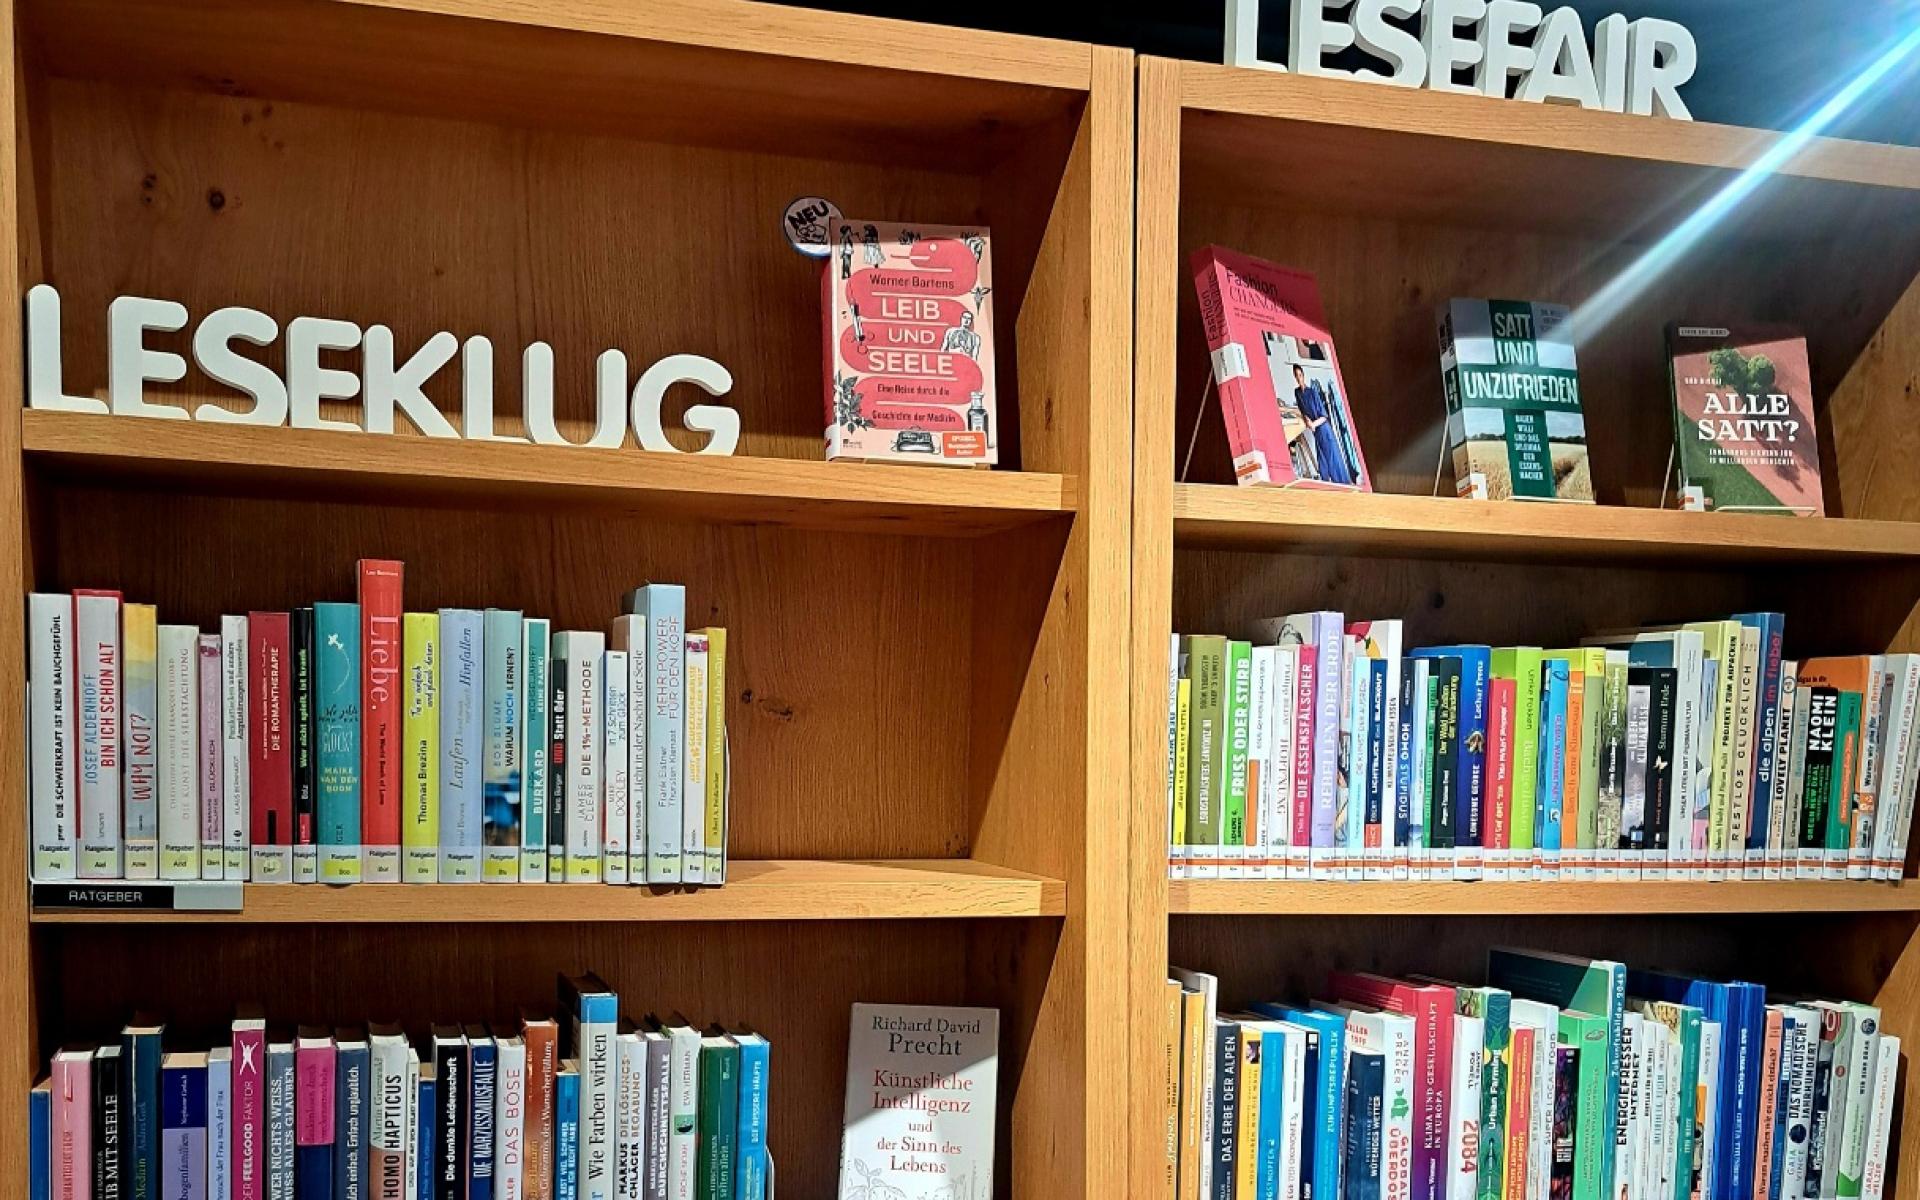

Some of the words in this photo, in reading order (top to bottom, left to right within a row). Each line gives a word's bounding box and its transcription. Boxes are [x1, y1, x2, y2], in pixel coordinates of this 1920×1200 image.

[1223, 0, 1697, 120] LESEFAIR
[788, 201, 829, 229] NEU
[870, 273, 908, 287] Werner
[912, 274, 954, 290] Bartens
[881, 297, 940, 320] LEIB
[1494, 313, 1531, 338] SATT
[888, 328, 935, 344] UND
[1497, 341, 1536, 365] UND
[27, 284, 740, 456] LESEKLUG
[869, 350, 954, 375] SEELE
[1465, 371, 1578, 404] UNZUFRIEDEN
[1704, 393, 1790, 415] ALLE
[1698, 419, 1799, 442] SATT?
[50, 615, 61, 685] BAUCHGEFÜHL
[658, 618, 667, 672] POWER
[670, 616, 679, 653] KOPF
[99, 643, 114, 664] ALT
[299, 649, 307, 676] krank
[370, 613, 399, 710] Liebe.
[459, 629, 473, 686] Hinfallen
[505, 647, 514, 691] LERNEN?
[634, 650, 643, 678] Seele
[1325, 629, 1339, 677] ERDE
[1767, 632, 1780, 679] fieber
[271, 647, 280, 731] ROMANTHERAPIE
[299, 679, 307, 691] ist
[634, 680, 643, 697] der
[669, 657, 679, 688] DEN
[1235, 658, 1249, 703] STIRB
[54, 688, 62, 711] KEIN
[84, 673, 97, 744] ALDENHOFF
[99, 669, 114, 713] SCHON
[505, 693, 514, 724] NOCH
[554, 688, 565, 712] Oder
[581, 661, 591, 750] 1%-METHODE
[657, 677, 667, 716] MEHR
[669, 691, 679, 719] FÜR
[1323, 680, 1338, 716] DER
[1374, 672, 1382, 721] BLACKOUT
[1660, 684, 1670, 706] Erde
[1722, 706, 1731, 746] PROJEKTE
[1728, 636, 1737, 680] ANPACKEN
[1765, 685, 1775, 702] im
[54, 714, 63, 728] IST
[100, 718, 114, 739] ICH
[554, 715, 565, 740] Statt
[634, 700, 643, 730] Nacht
[1233, 706, 1248, 749] ODER
[1298, 664, 1312, 775] ESSENSFÄLSCHER
[1657, 710, 1668, 750] Stumme
[1735, 665, 1752, 759] GLÜCKLICH
[1762, 708, 1775, 752] alpen
[1808, 695, 1824, 750] NAOMI
[1822, 696, 1837, 751] KLEIN
[130, 714, 151, 756] NOT?
[272, 734, 280, 750] DIE
[299, 723, 307, 746] nicht
[505, 726, 514, 767] WARUM
[634, 735, 643, 750] der
[1400, 723, 1410, 760] HOMO
[1779, 708, 1791, 754] PLANET
[55, 731, 63, 800] SCHWERKRAFT
[84, 749, 98, 785] JOSEF
[101, 744, 115, 767] BIN
[299, 749, 307, 767] Wer
[418, 740, 427, 779] Brezina
[449, 738, 464, 789] Laufen
[554, 742, 563, 763] UND
[581, 754, 591, 776] DIE
[634, 754, 644, 765] in
[1320, 720, 1338, 808] REBELLEN
[1759, 756, 1771, 782] die
[131, 763, 152, 800] WHY
[534, 749, 544, 814] BURKARD
[616, 769, 626, 817] DOOLEY
[634, 769, 644, 792] Licht
[1232, 754, 1246, 796] FRISS
[1297, 778, 1308, 798] DIE
[1399, 764, 1408, 819] STUPIDUS
[1776, 759, 1786, 800] LOVELY
[1811, 765, 1820, 786] DEAL
[56, 804, 64, 818] DIE
[418, 782, 427, 824] Thomas
[578, 784, 586, 819] JAMES
[586, 783, 594, 822] CLEAR
[1731, 768, 1744, 841] RESTLOS
[1808, 789, 1817, 809] NEW
[1807, 810, 1816, 840] GREEN
[69, 891, 143, 903] RATGEBER
[872, 1016, 931, 1031] Richard
[937, 1019, 981, 1034] David
[1427, 1001, 1437, 1085] GESELLSCHAFT
[590, 1034, 607, 1087] wirken
[889, 1033, 962, 1055] Precht
[1224, 1036, 1236, 1074] ALPEN
[1791, 1023, 1807, 1095] NOMADISCHE
[272, 1076, 283, 1118] WEISS,
[285, 1067, 294, 1126] GLAUBEN
[446, 1057, 457, 1125] Leidenschaft
[503, 1068, 520, 1118] BÖSE
[873, 1070, 973, 1091] Künstliche
[1224, 1078, 1234, 1101] DER
[1617, 1027, 1632, 1145] ENERGIEFRESSER
[1803, 1041, 1816, 1119] JAHRHUNDERT
[244, 1081, 254, 1120] FAKTOR
[385, 1074, 402, 1149] HAPTICUS
[473, 1060, 494, 1158] NARZISSMUSFALLE
[873, 1092, 971, 1116] Intelligenz
[1372, 1095, 1380, 1128] WETTER
[1426, 1087, 1434, 1111] UND
[1434, 1090, 1443, 1133] EUROPA
[1488, 1097, 1498, 1130] Urban
[1789, 1098, 1800, 1119] DAS
[105, 1094, 118, 1143] SEELE
[588, 1093, 607, 1145] Farben
[909, 1120, 933, 1132] und
[1222, 1104, 1234, 1134] ERBE
[1424, 1114, 1433, 1149] KLIMA
[243, 1123, 253, 1181] FEELGOOD
[272, 1122, 281, 1168] NICHTS
[285, 1130, 294, 1167] ALLES
[446, 1126, 456, 1162] dunkle
[505, 1127, 518, 1164] DAS
[877, 1137, 897, 1150] der
[901, 1136, 938, 1153] Sinn
[943, 1141, 961, 1155] des
[1221, 1138, 1232, 1161] DAS
[1434, 1137, 1441, 1148] IN
[1461, 1120, 1478, 1174] 2084
[105, 1147, 118, 1179] MIT
[385, 1155, 400, 1198] HOMO
[446, 1164, 456, 1180] Die
[474, 1162, 492, 1177] DIE
[588, 1150, 605, 1180] Wie
[891, 1155, 946, 1173] Lebens
[272, 1173, 281, 1200] WER
